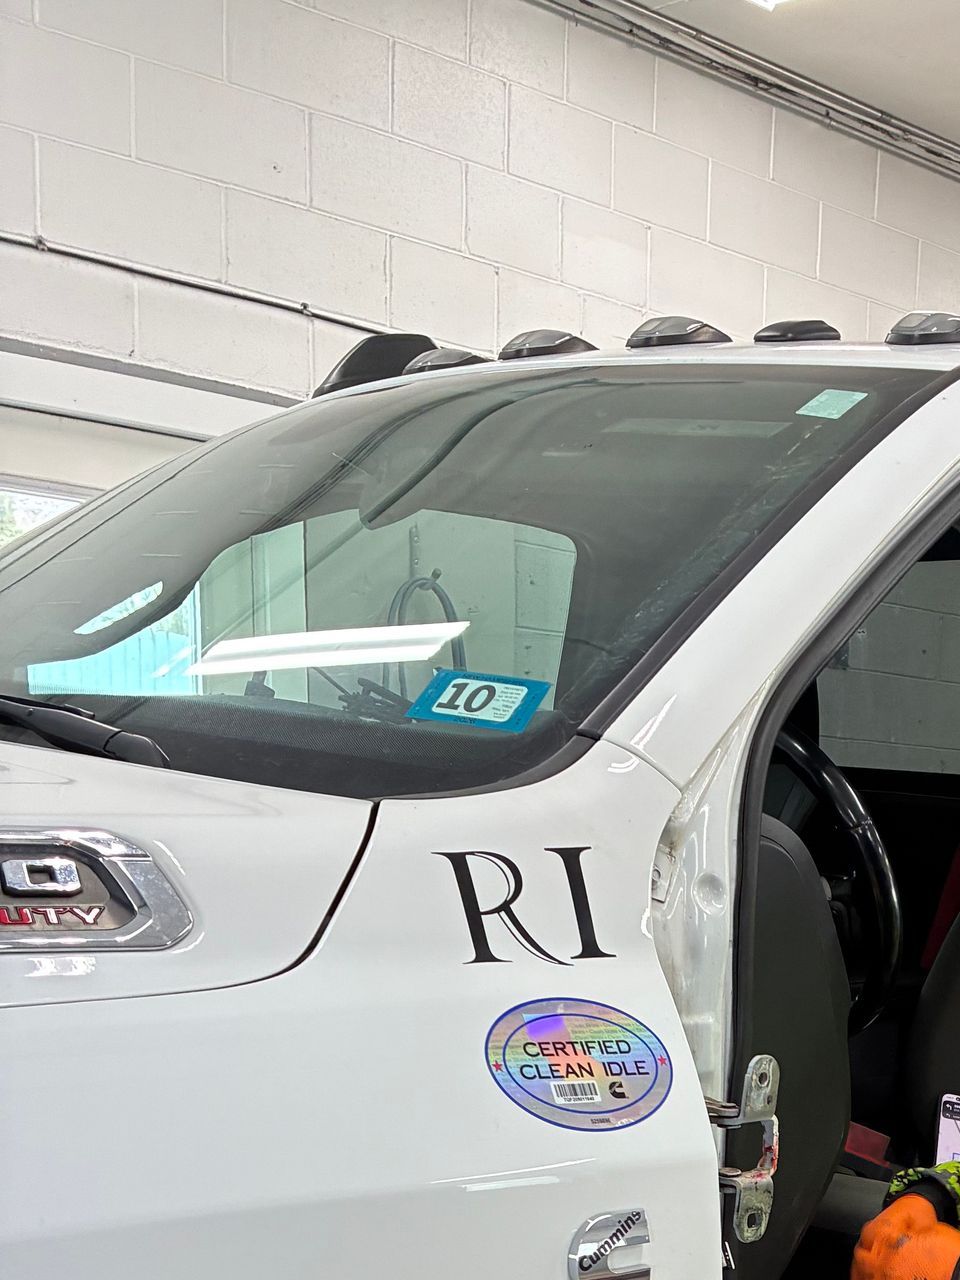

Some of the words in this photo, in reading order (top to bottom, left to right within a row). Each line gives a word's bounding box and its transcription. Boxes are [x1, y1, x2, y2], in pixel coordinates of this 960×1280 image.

[435, 682, 497, 713] 10
[430, 846, 617, 966] RI
[522, 1039, 632, 1058] CERTIFIED
[519, 1061, 595, 1080] CLEAN
[602, 1060, 650, 1077] IDLE
[578, 1210, 642, 1272] Cummins
